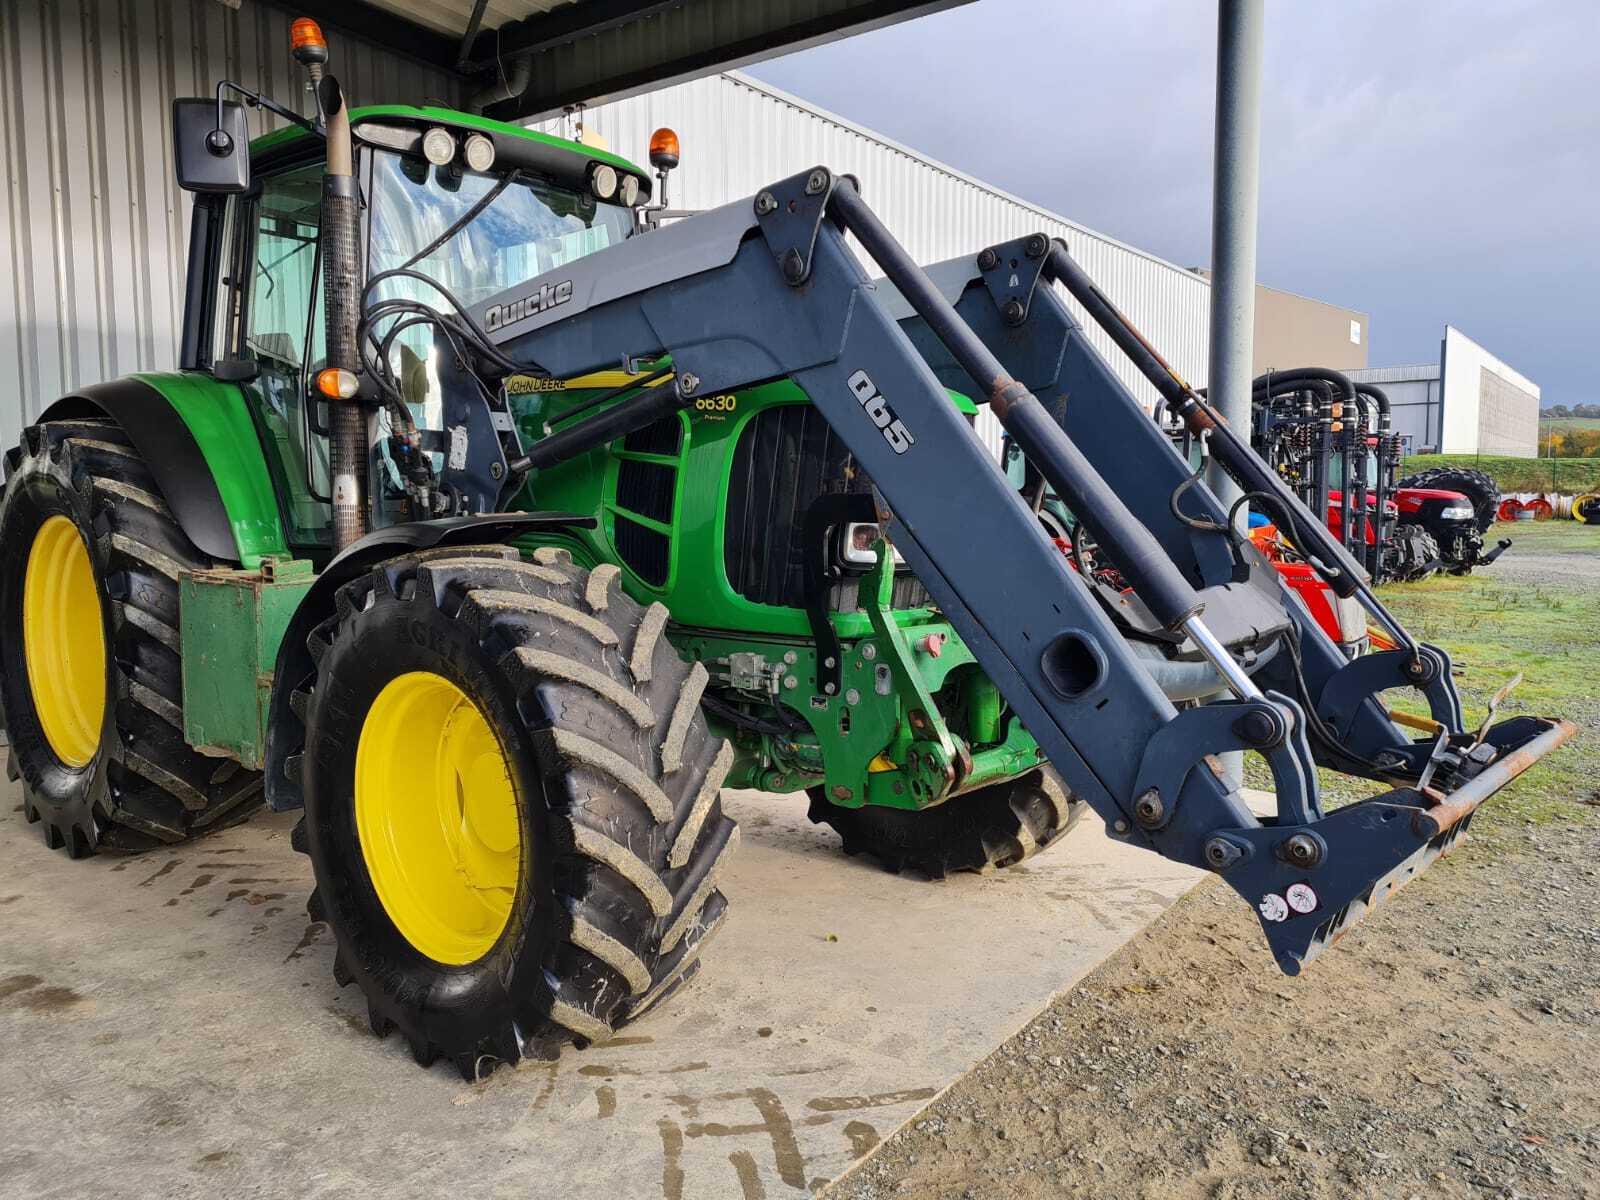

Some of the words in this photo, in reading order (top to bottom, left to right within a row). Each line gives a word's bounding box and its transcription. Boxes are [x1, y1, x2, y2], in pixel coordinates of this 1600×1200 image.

[485, 279, 573, 334] Quicke
[510, 381, 532, 392] JOHN
[534, 379, 566, 390] DEERE
[695, 395, 736, 411] 6630
[846, 368, 916, 455] Q65
